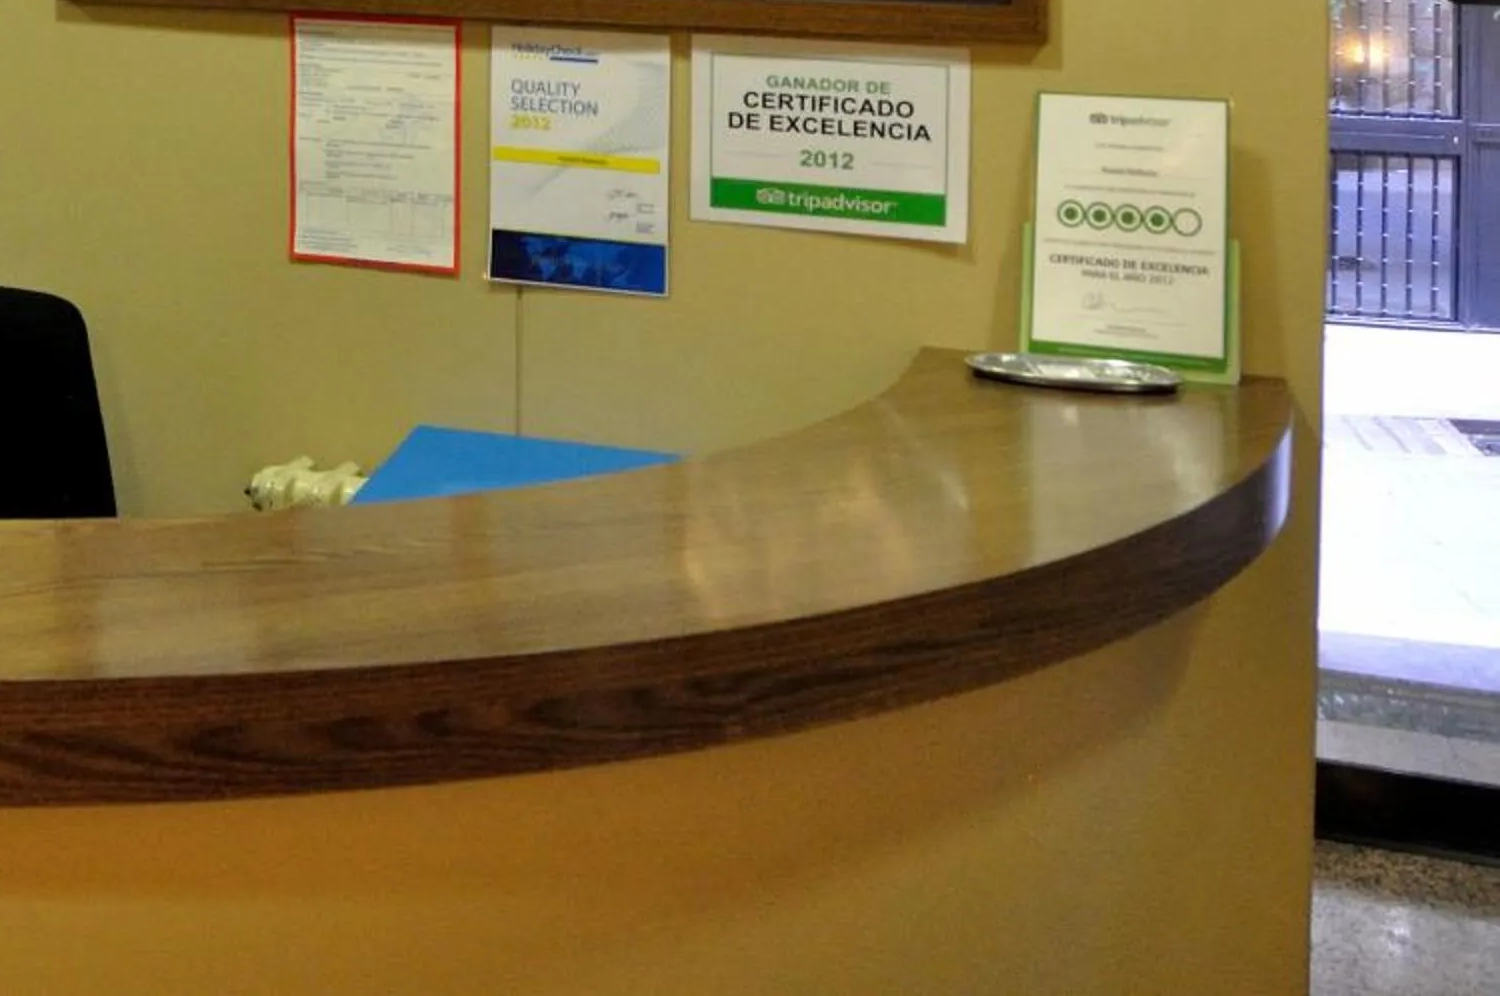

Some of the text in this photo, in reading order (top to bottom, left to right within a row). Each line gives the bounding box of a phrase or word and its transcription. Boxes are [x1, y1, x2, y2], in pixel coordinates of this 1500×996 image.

[511, 77, 581, 97] QUALITY
[766, 74, 892, 94] GANADOR DE
[510, 95, 598, 116] SELECTION
[742, 91, 915, 119] CERTIFICADO
[511, 114, 551, 130] 2012
[728, 111, 932, 142] DE EXCELENCIA
[800, 149, 855, 170] 2012
[788, 191, 892, 214] tripadvisor
[1049, 254, 1209, 276] CERTIFICADO DE EXCELENCIA
